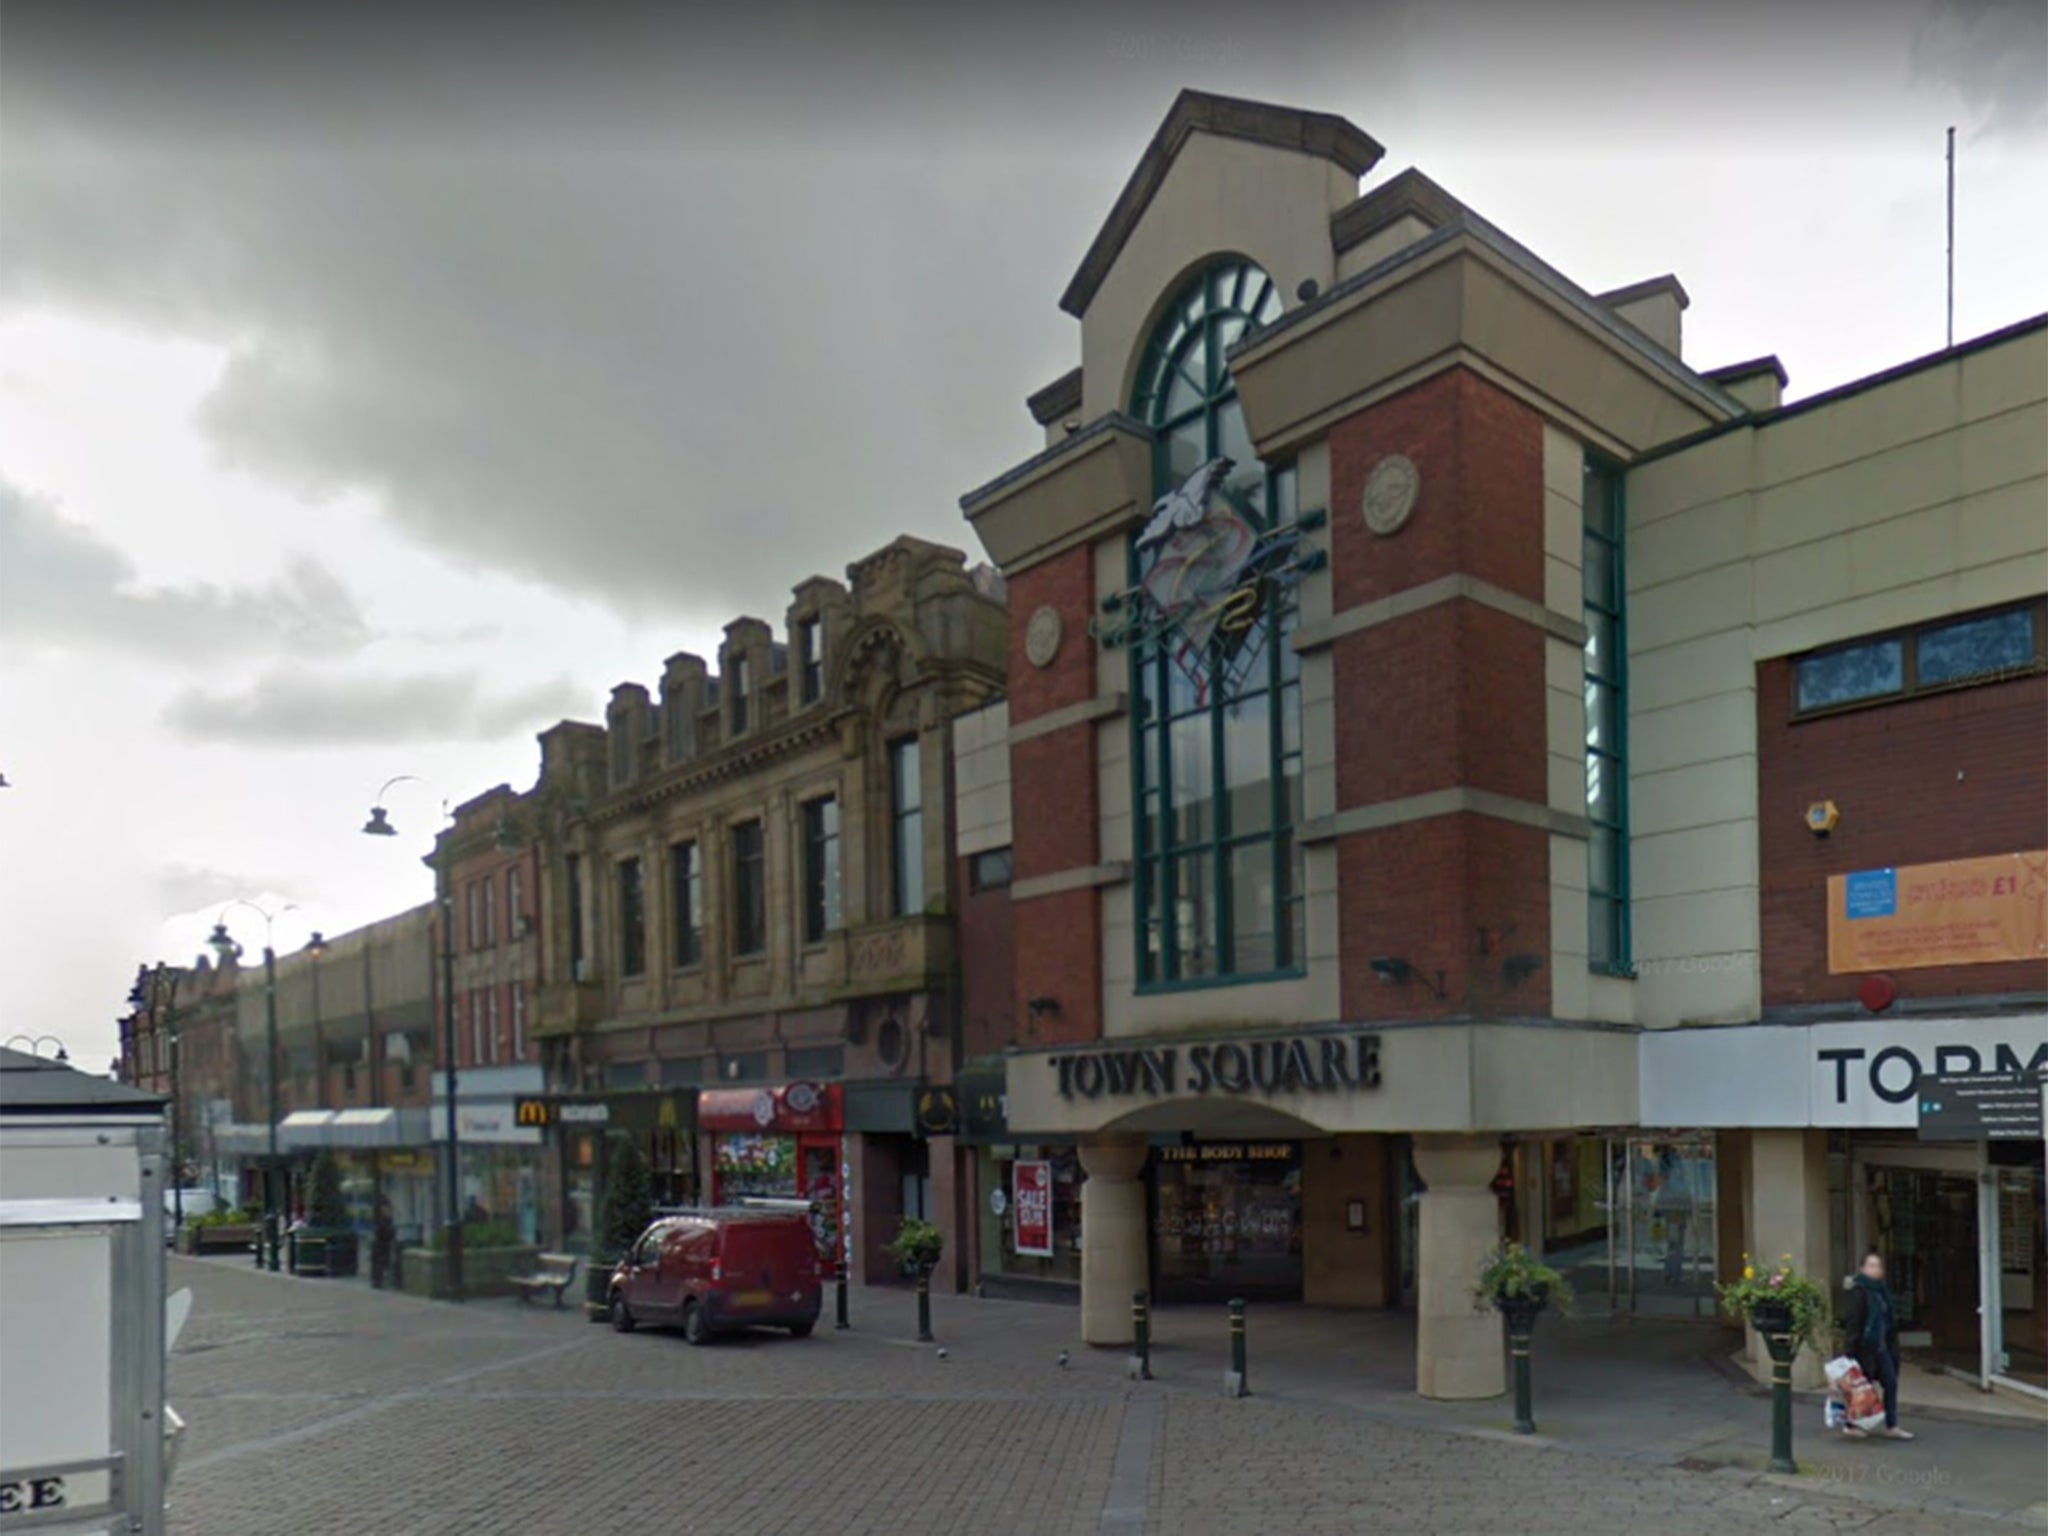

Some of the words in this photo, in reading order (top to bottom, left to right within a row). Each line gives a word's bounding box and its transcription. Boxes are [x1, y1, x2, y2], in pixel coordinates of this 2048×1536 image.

[1993, 877, 2016, 896] £1
[1049, 1050, 1176, 1099] TOWN
[1188, 1035, 1382, 1092] SQUARE
[1162, 1147, 1196, 1160] THE
[1201, 1145, 1243, 1159] BODY
[1247, 1143, 1291, 1158] SHOP
[1017, 1190, 1045, 1210] SALE
